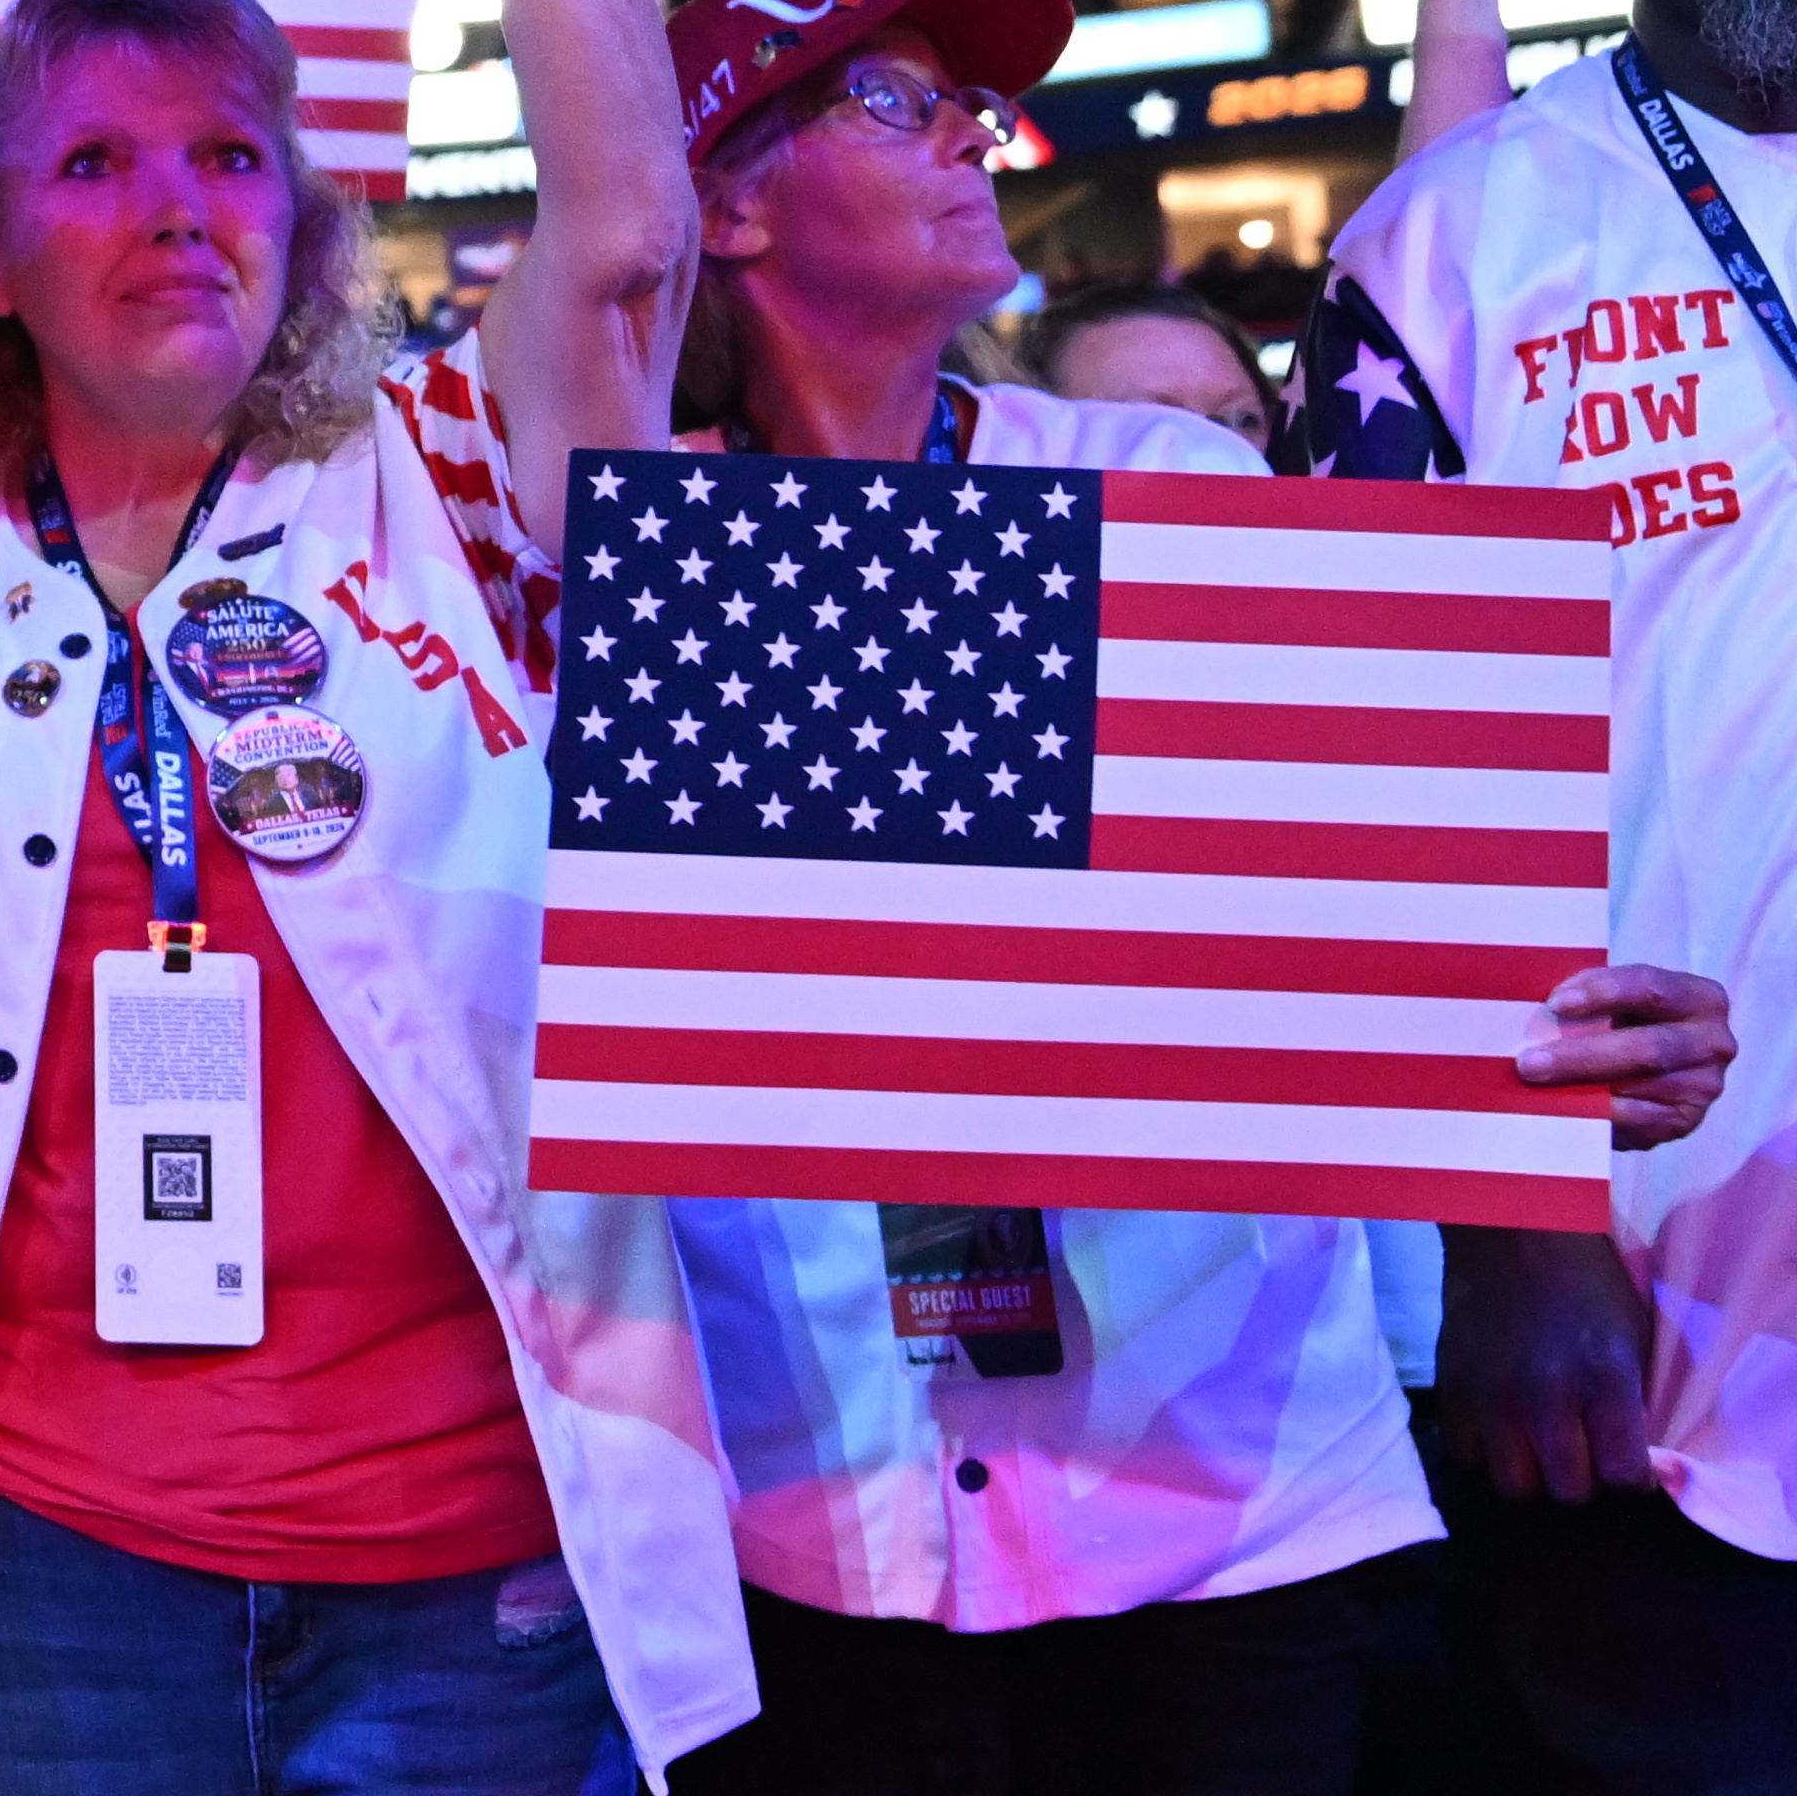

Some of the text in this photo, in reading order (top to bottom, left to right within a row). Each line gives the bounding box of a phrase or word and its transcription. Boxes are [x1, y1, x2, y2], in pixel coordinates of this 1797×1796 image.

[1638, 99, 1695, 172] DALLAS
[1588, 461, 1742, 551] OES
[206, 604, 275, 625] SALUTE
[205, 622, 291, 642] AMERICA
[235, 719, 322, 742] REPUBLICAN
[236, 730, 324, 753] MIDTERM
[234, 741, 330, 765] CONVENTION
[155, 752, 187, 868] DALLAS
[307, 806, 341, 822] TEXAS
[907, 1285, 1032, 1316] SPECIAL GUEST
